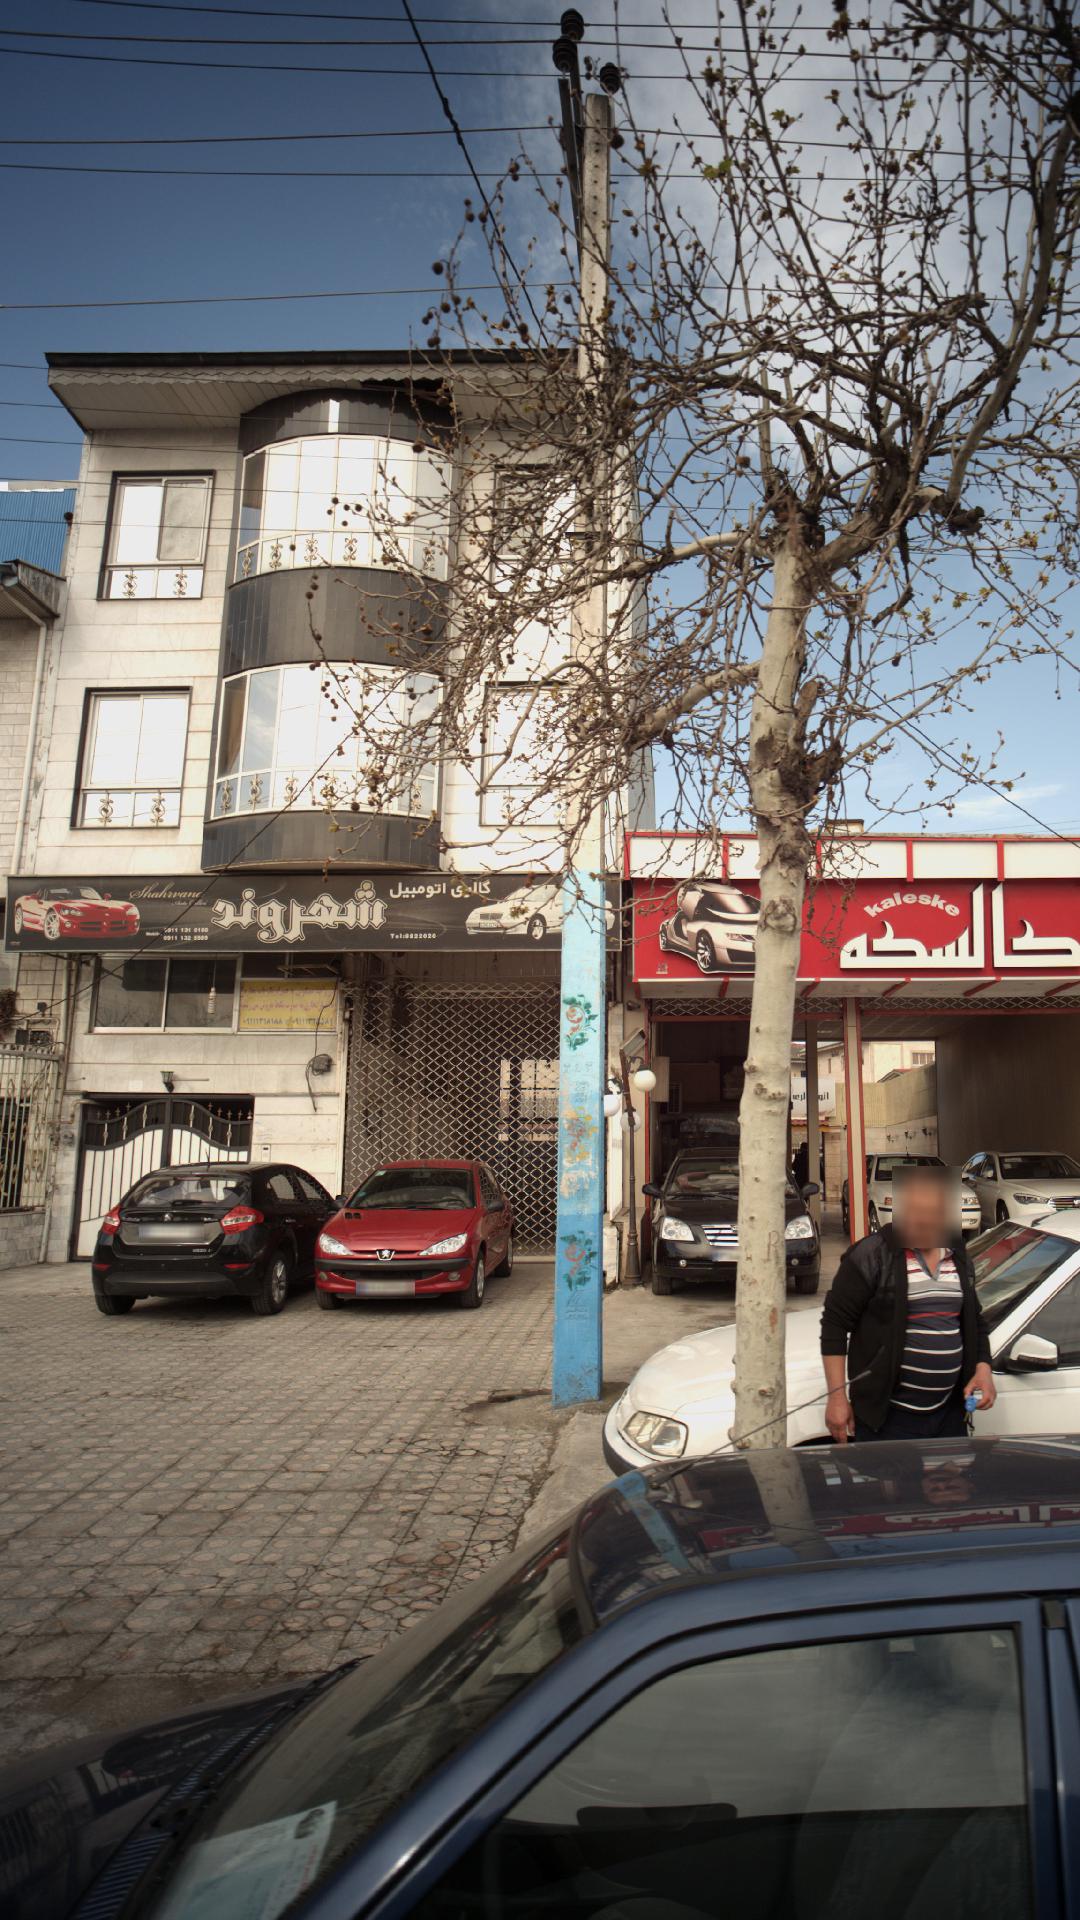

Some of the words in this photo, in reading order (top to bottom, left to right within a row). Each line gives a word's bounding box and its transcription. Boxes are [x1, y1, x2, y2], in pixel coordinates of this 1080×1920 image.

[389, 881, 447, 899] اتومبیل
[863, 890, 961, 918] kaleske
[211, 880, 388, 943] شهروند
